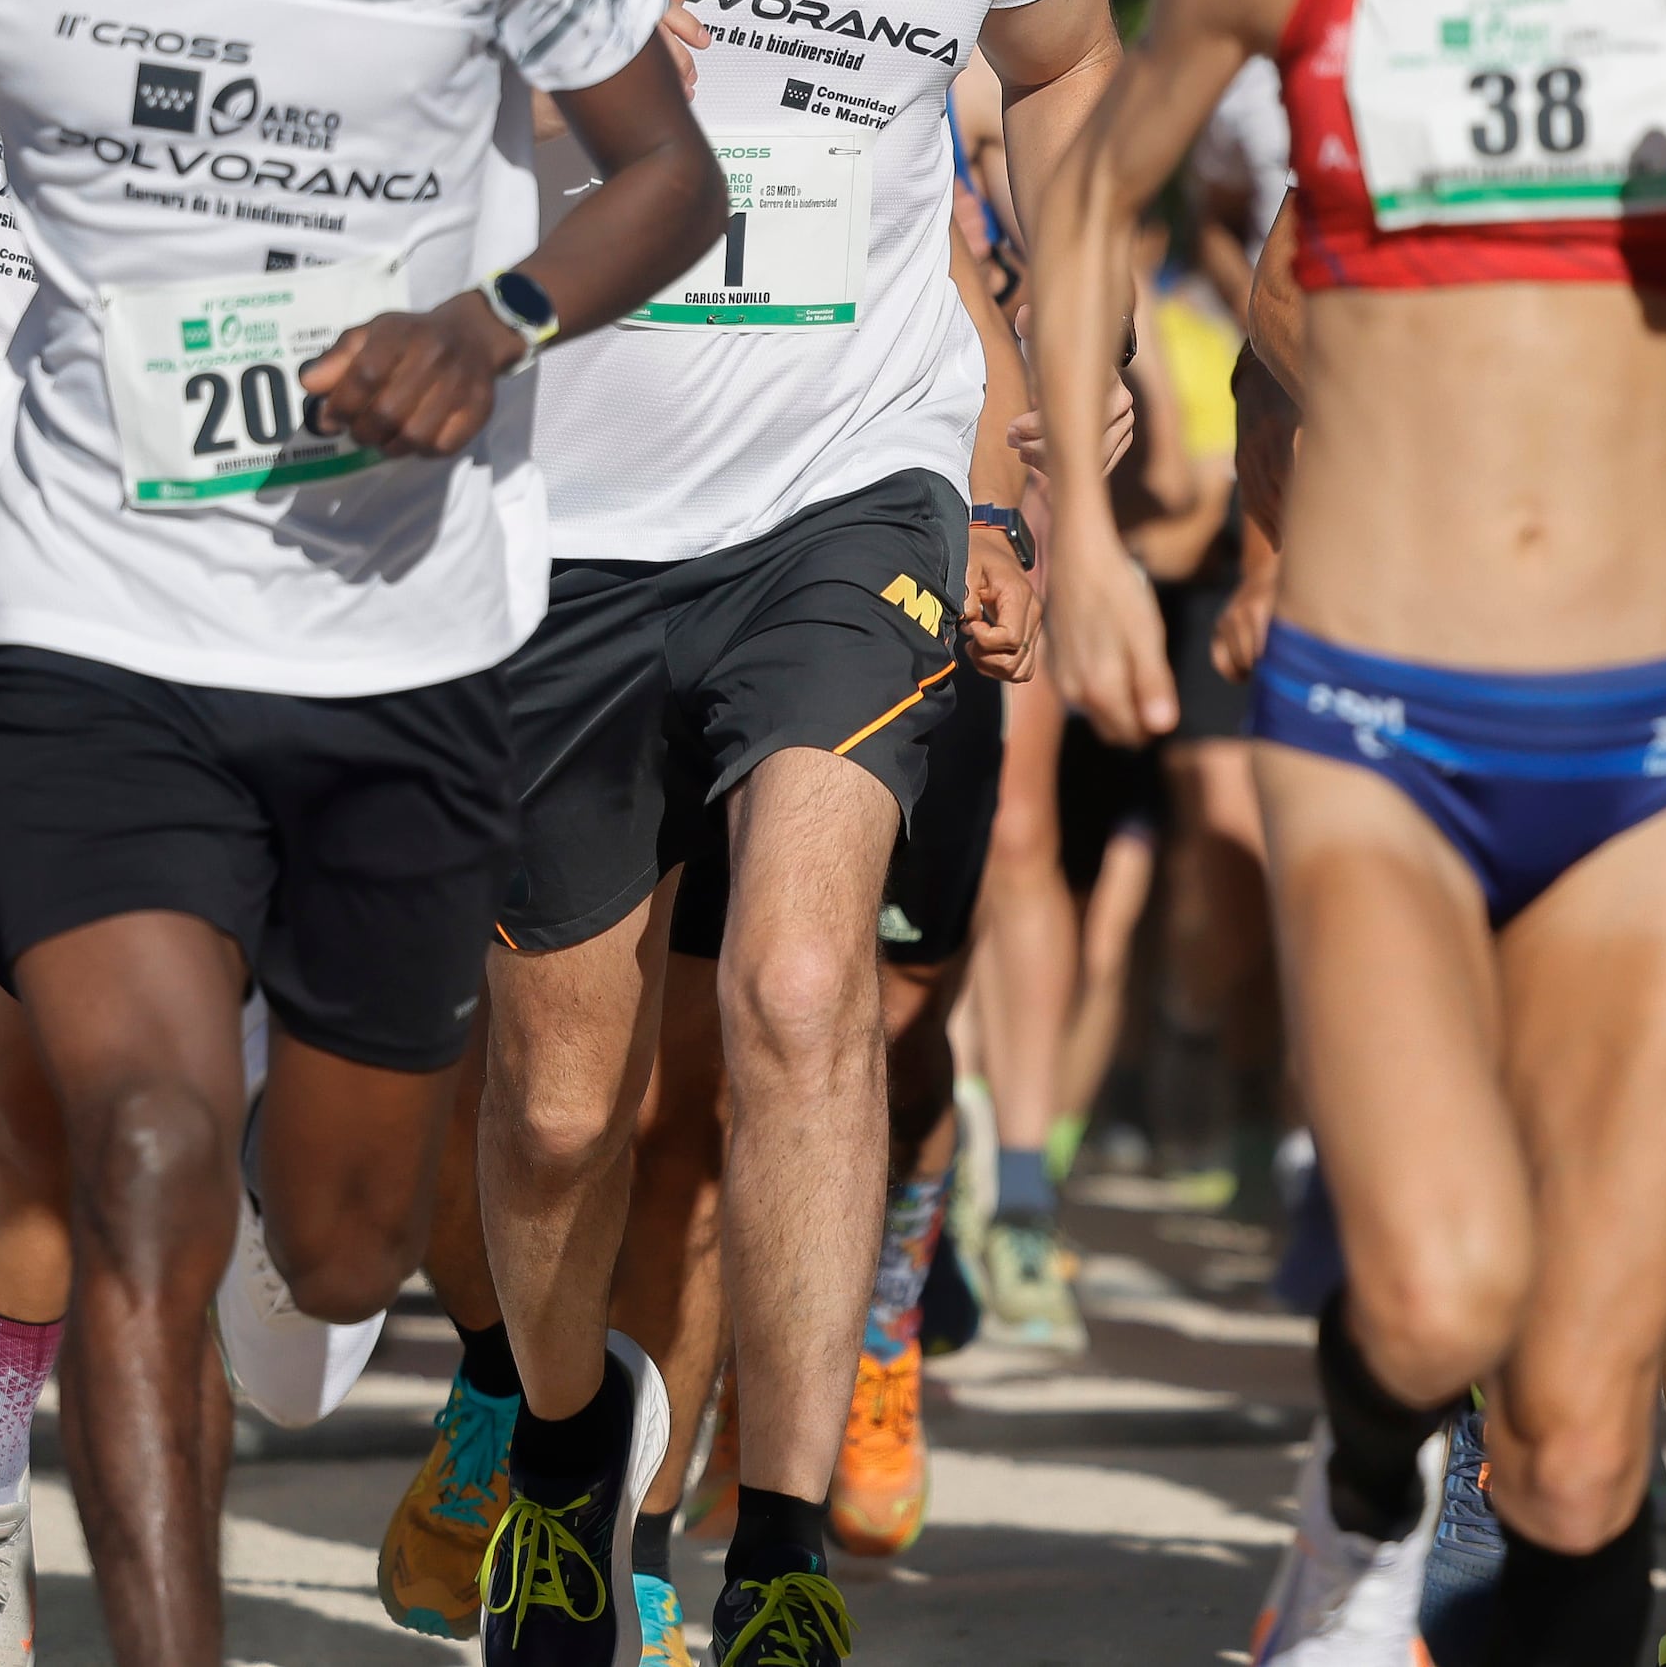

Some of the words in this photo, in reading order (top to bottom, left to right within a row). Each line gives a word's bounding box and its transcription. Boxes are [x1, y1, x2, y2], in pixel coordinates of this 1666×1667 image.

[92, 21, 252, 65] CROSS
[728, 26, 746, 47] de
[748, 31, 764, 51] la
[766, 35, 866, 72] biodiversidad
[816, 85, 898, 117] Comunidad
[1469, 66, 1588, 157] 38
[263, 105, 340, 130] ARCO
[810, 101, 831, 117] de
[834, 105, 891, 131] Madrid
[262, 124, 337, 152] VERDE
[56, 128, 442, 204] POLVORANCA
[726, 185, 752, 194] ERDE
[777, 185, 797, 197] MAYO
[799, 197, 838, 209] biodiversidad
[684, 292, 727, 305] CARLOS
[728, 291, 771, 304] NOVILLO
[806, 308, 834, 316] Comunidad
